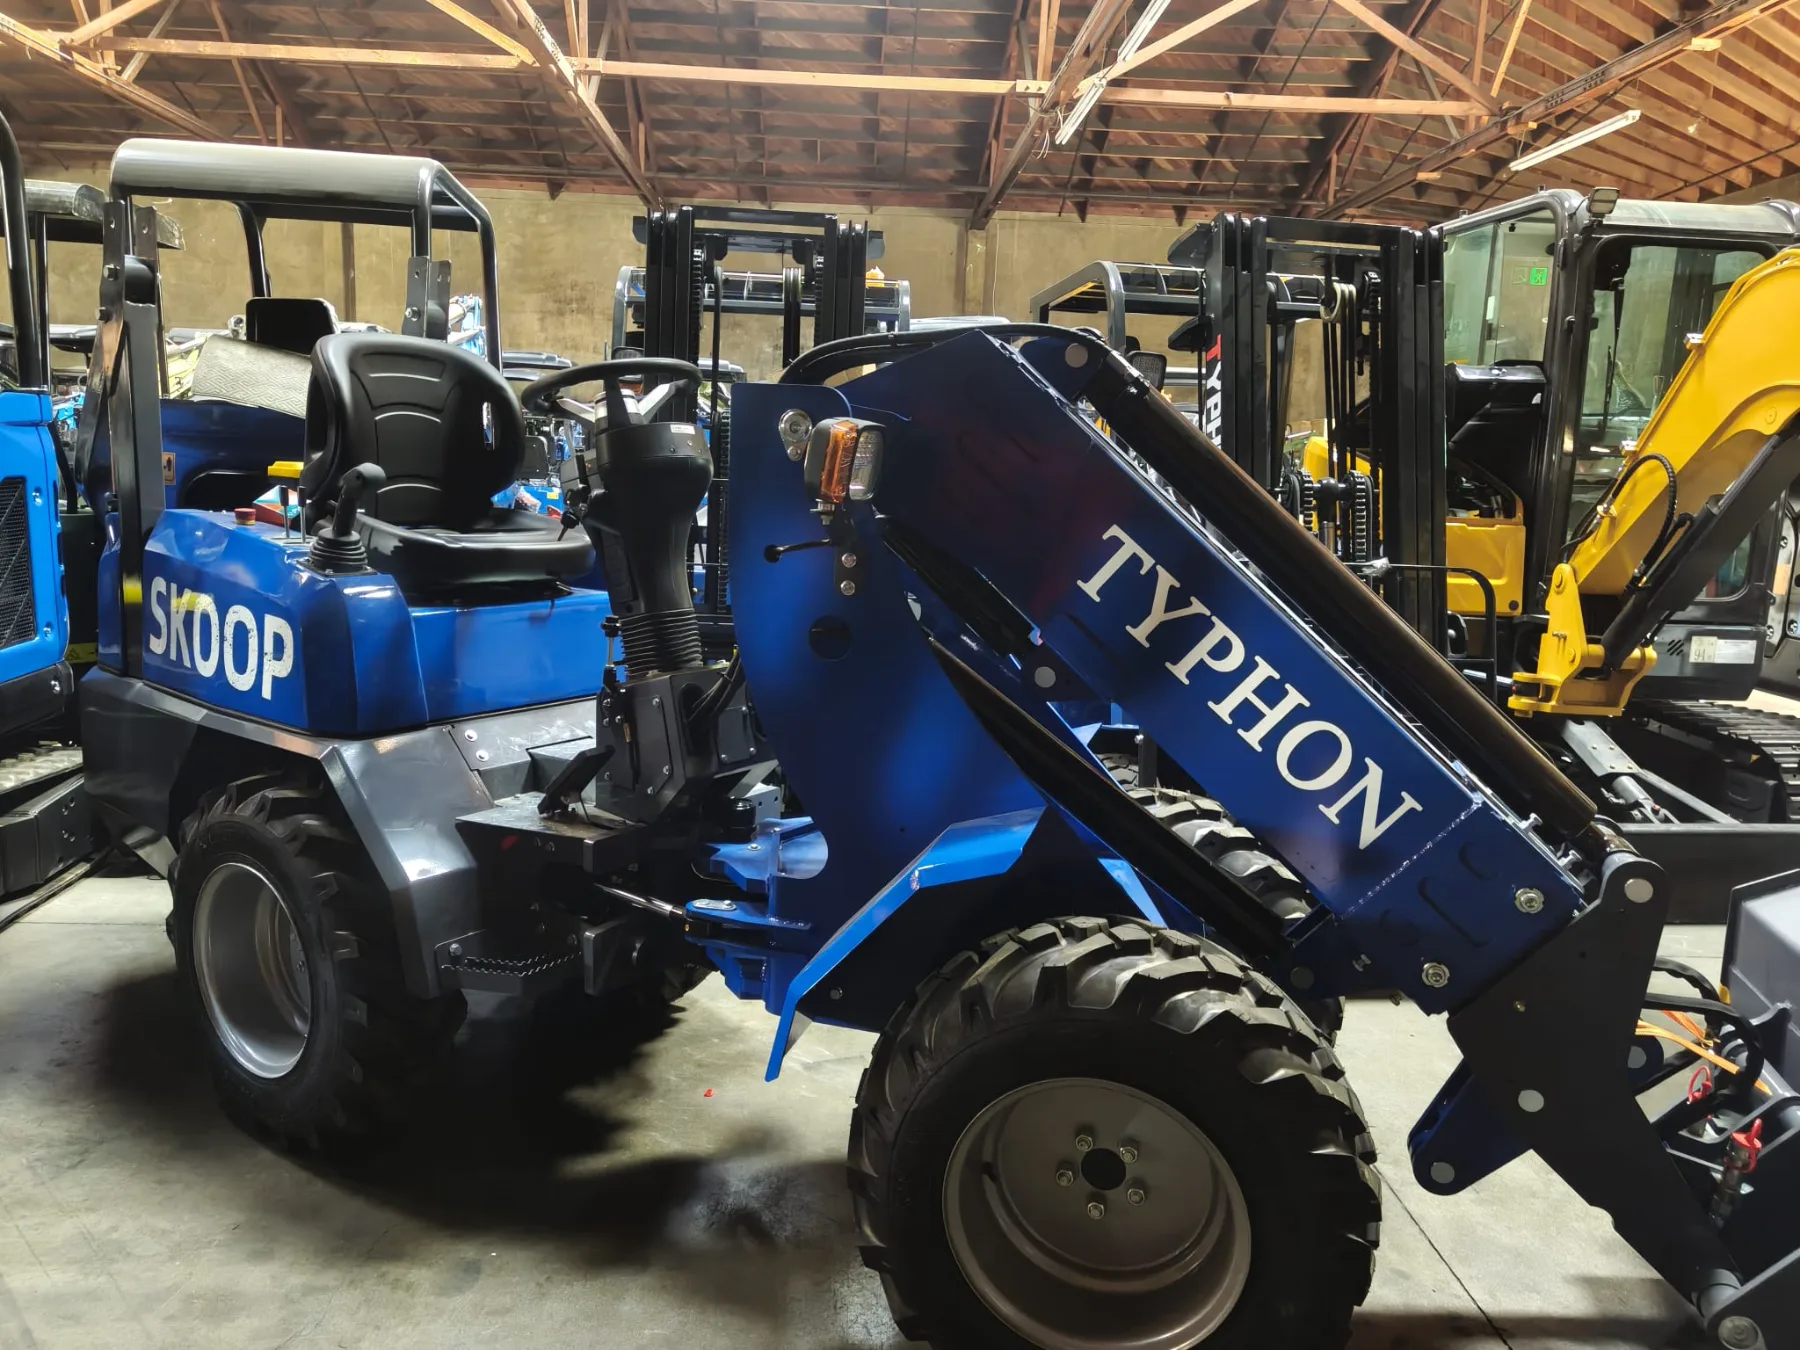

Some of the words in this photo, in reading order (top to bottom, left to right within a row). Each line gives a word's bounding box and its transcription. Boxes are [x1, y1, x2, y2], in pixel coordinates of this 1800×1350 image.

[1205, 334, 1222, 450] TYPH
[149, 576, 294, 700] SKOOP
[1076, 524, 1423, 850] TYPHON
